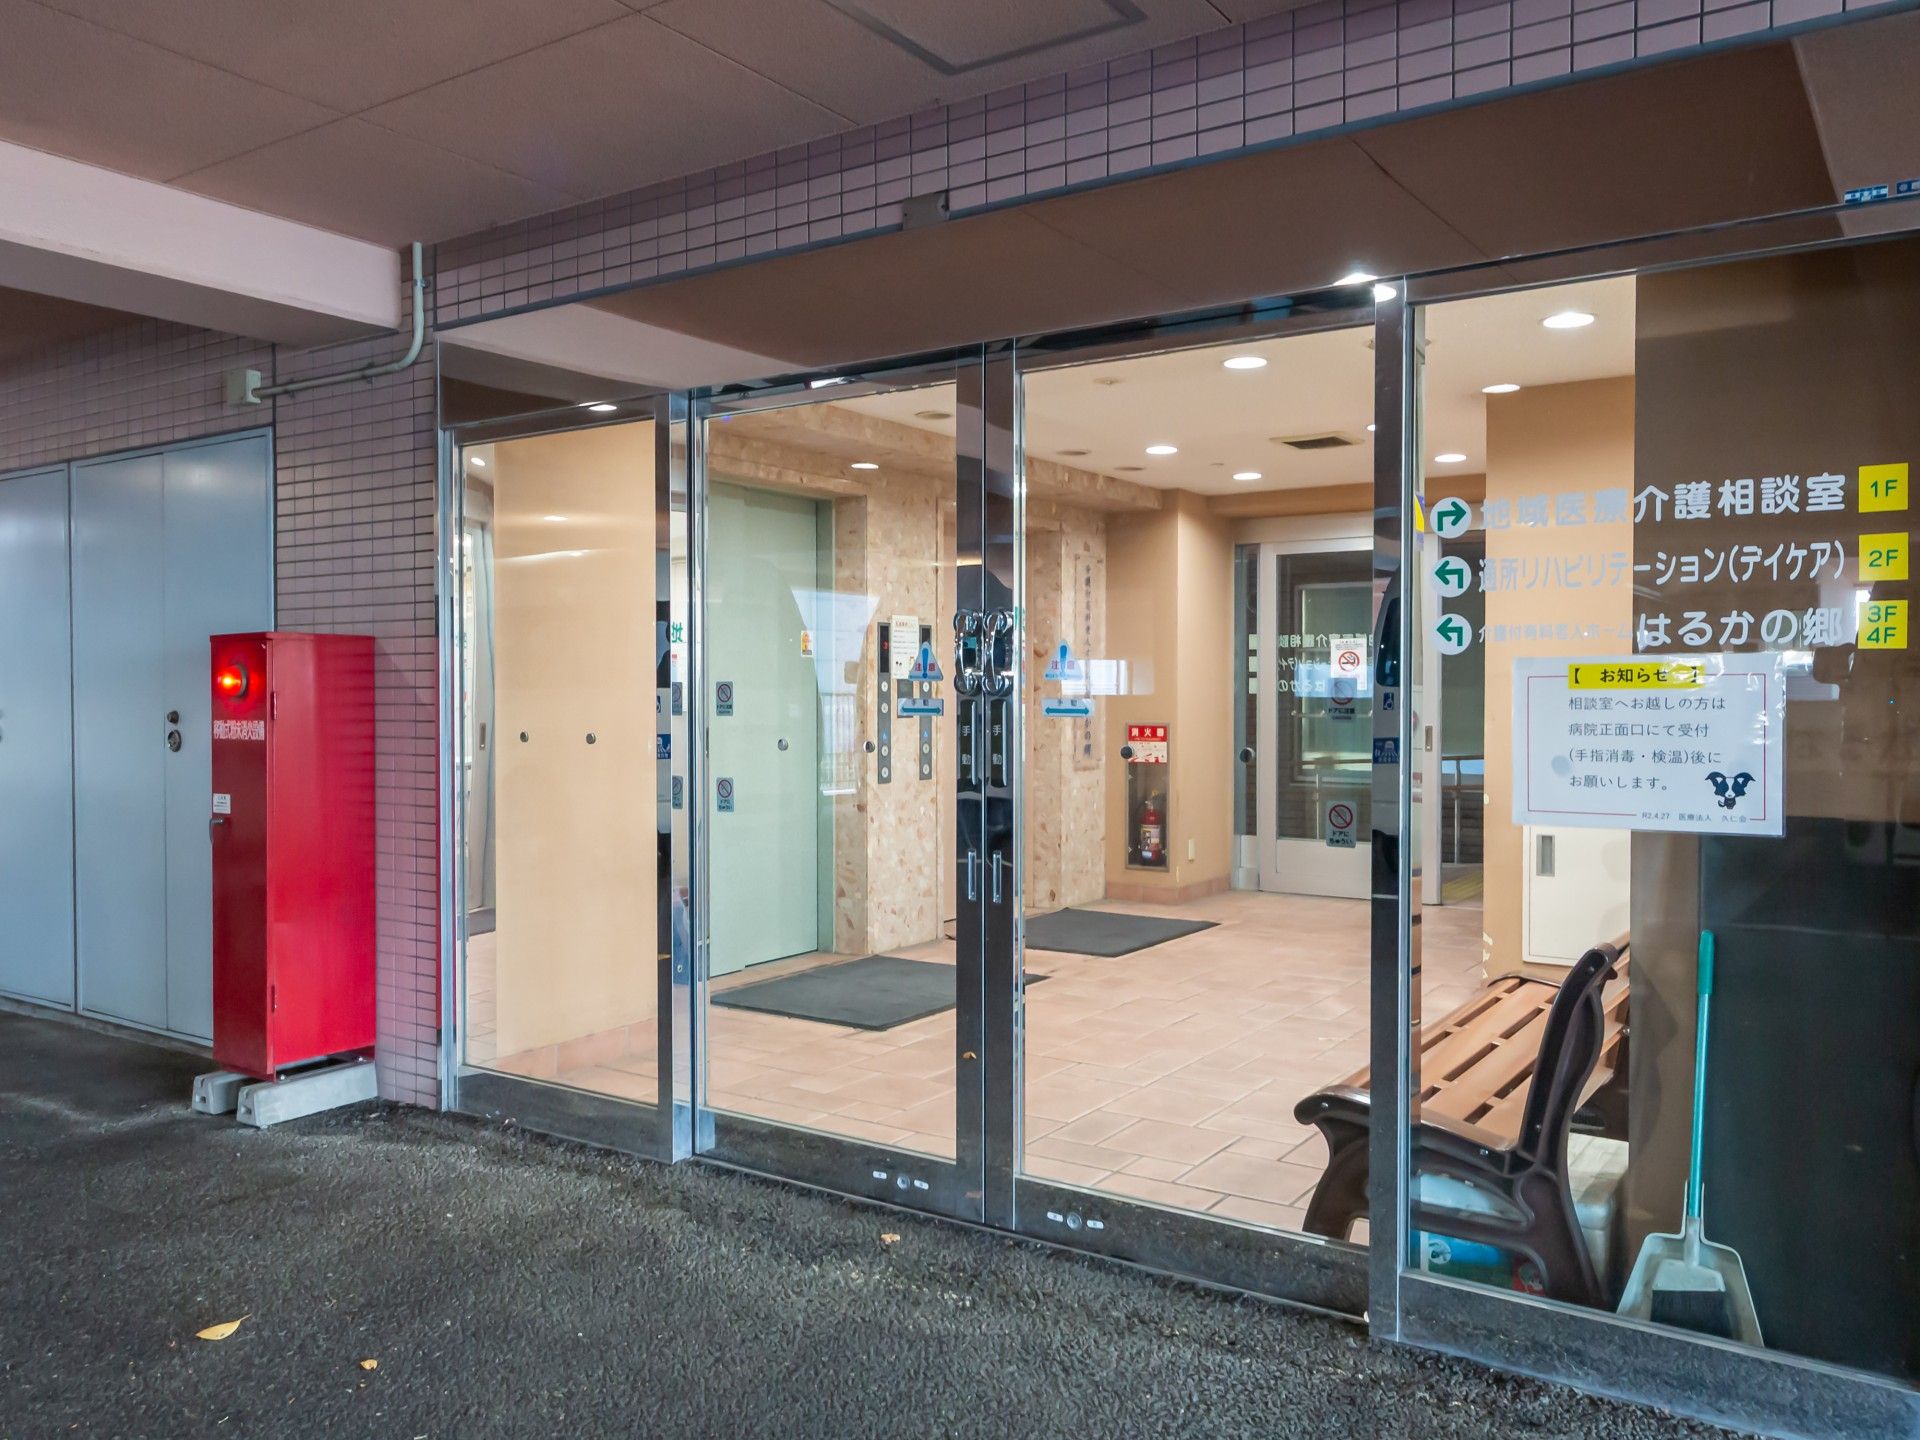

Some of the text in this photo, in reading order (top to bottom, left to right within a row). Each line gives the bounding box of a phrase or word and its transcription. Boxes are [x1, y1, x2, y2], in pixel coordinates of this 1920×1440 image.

[1480, 472, 1898, 530] 地域医療介護相談室 1F
[1479, 540, 1899, 593] 通所リハビリテーション(デイケア) 2F
[1638, 608, 1843, 647] はるかの郷
[1867, 605, 1897, 623] 3F
[1866, 627, 1896, 644] 4F
[1568, 696, 1726, 711] 相談室へお越しの方は
[1568, 722, 1709, 738] 病院正面口にて受付
[1569, 748, 1722, 765] (手指消毒・検温)後に
[1569, 773, 1669, 791] お願いします。
[1678, 812, 1712, 822] 医療法人
